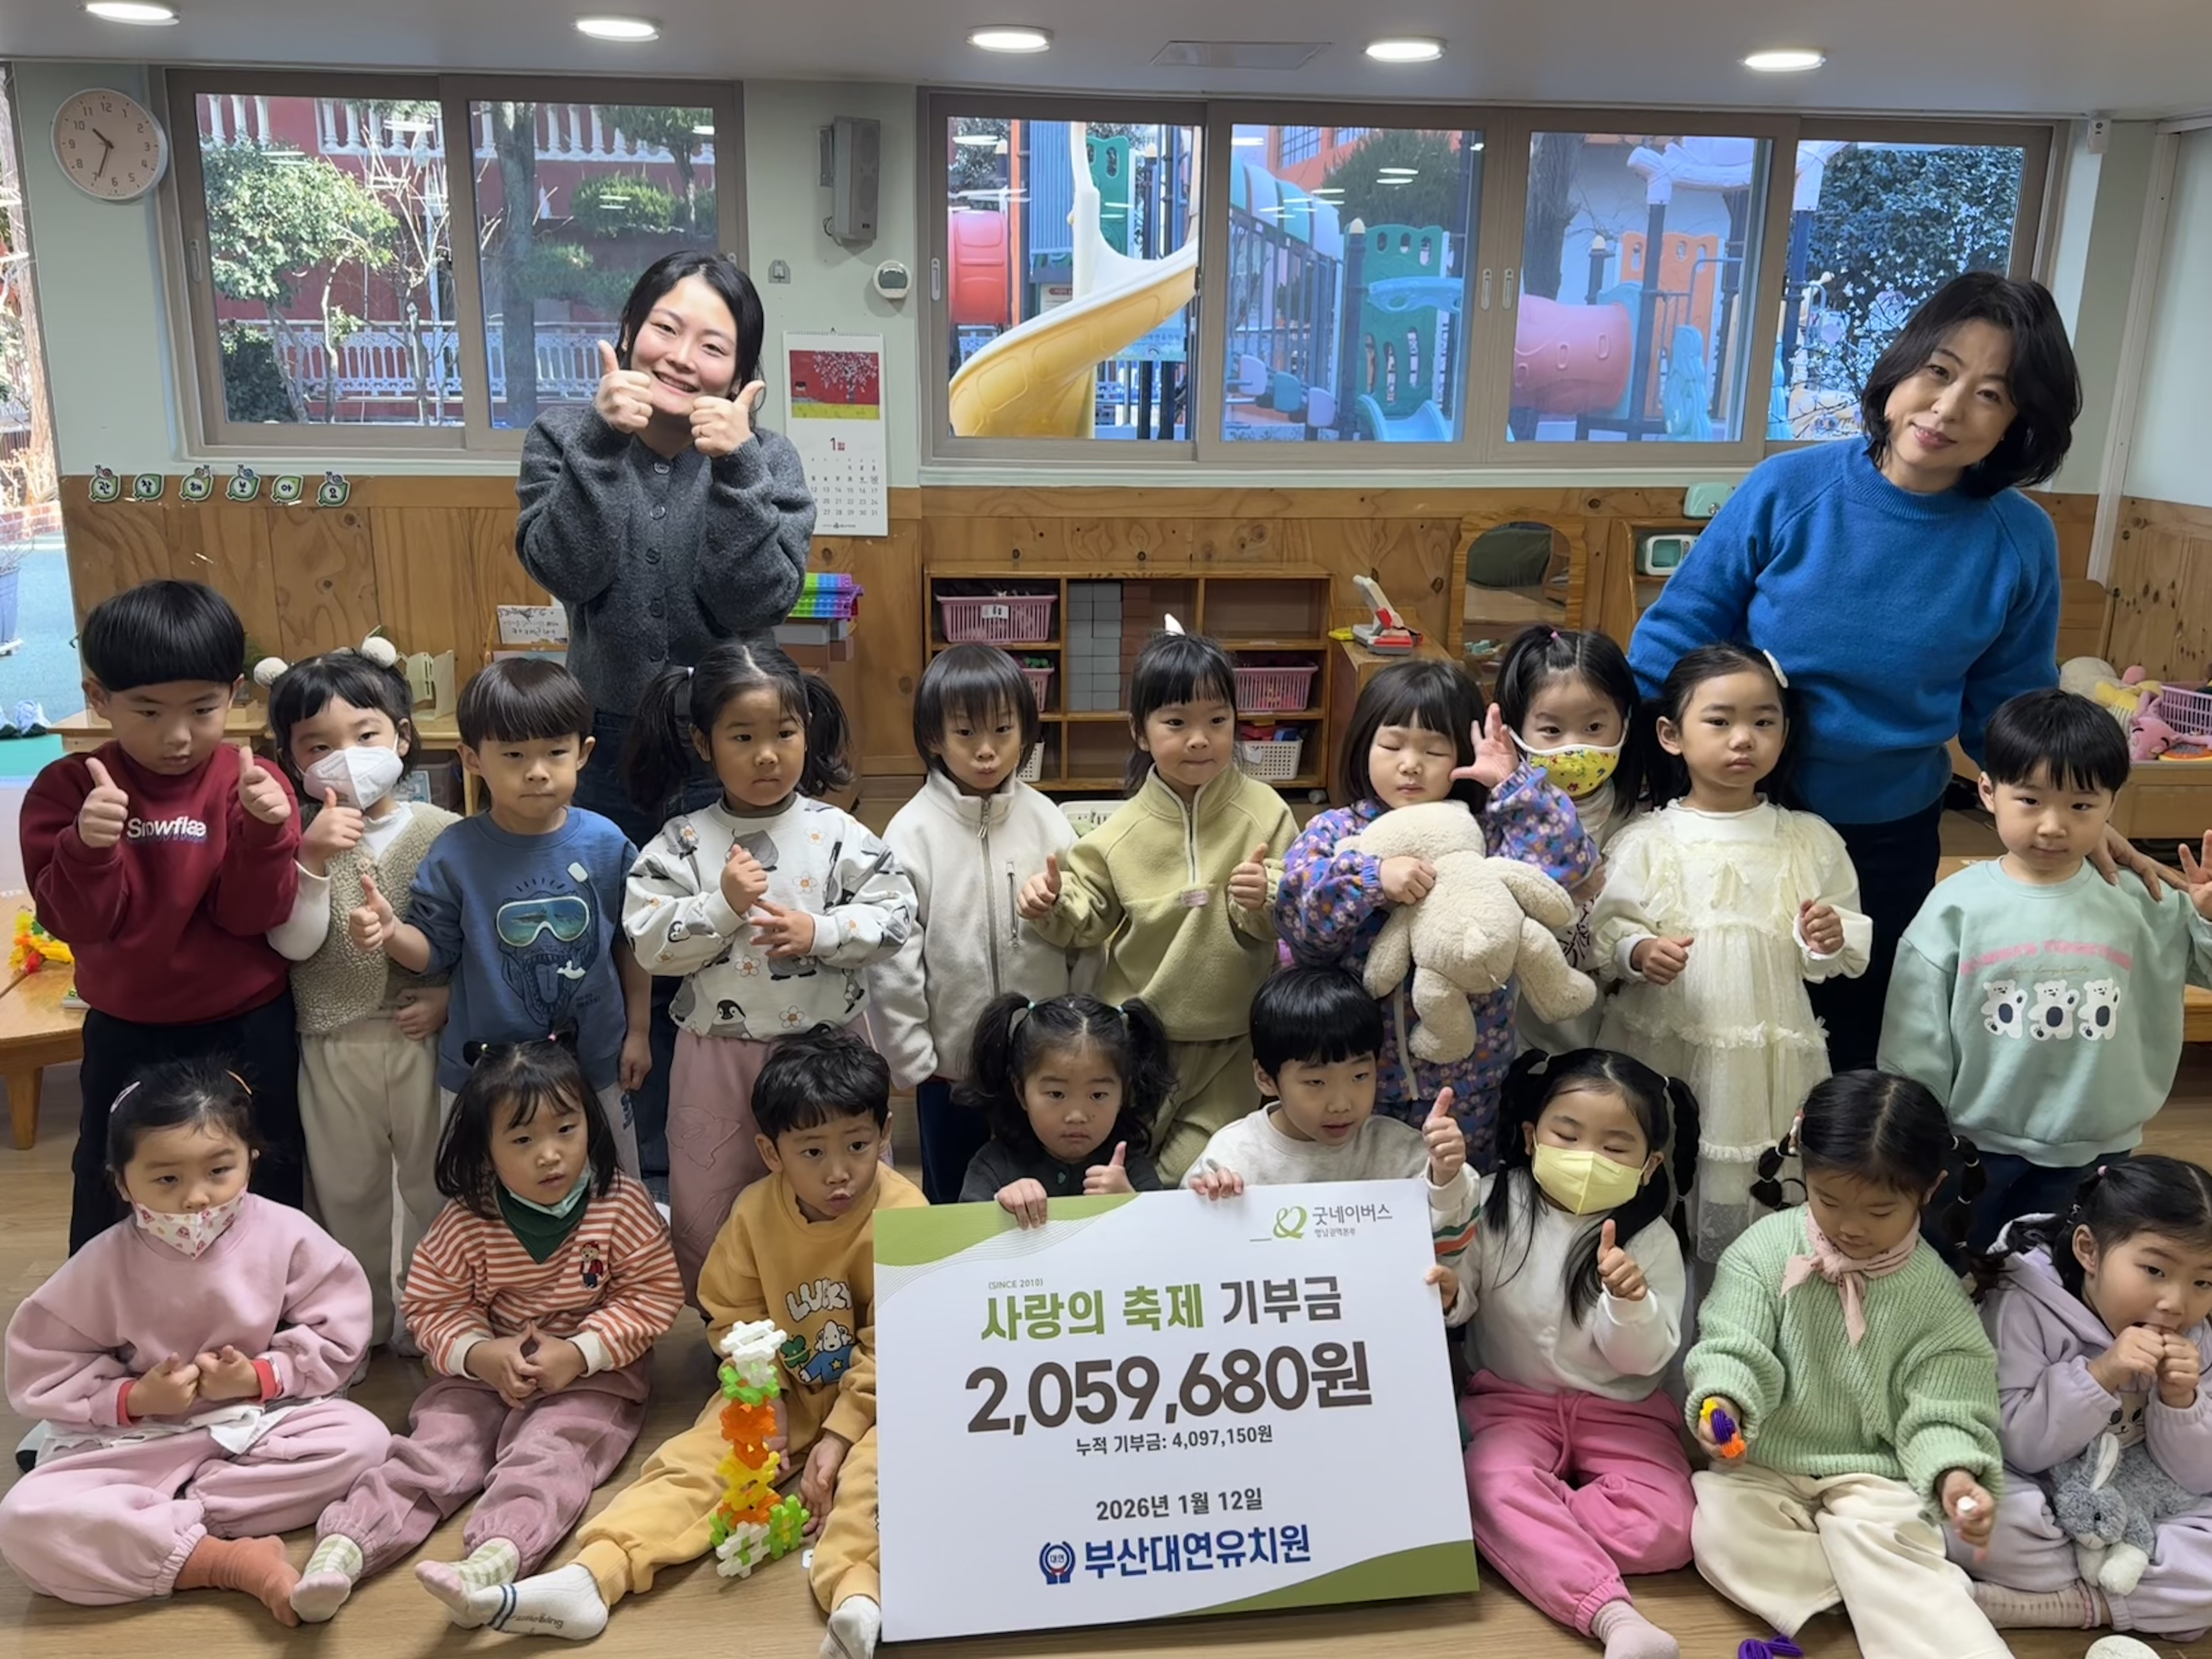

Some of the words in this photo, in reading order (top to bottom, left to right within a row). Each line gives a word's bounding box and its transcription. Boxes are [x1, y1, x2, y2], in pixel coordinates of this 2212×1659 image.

[83, 107, 93, 116] 11
[101, 102, 112, 112] 12
[122, 109, 127, 118] 1
[73, 120, 85, 131] 10
[137, 123, 144, 133] 2
[69, 139, 75, 148] 9
[144, 142, 150, 151] 3
[76, 159, 82, 168] 8
[112, 177, 118, 187] 6
[128, 172, 135, 182] 5
[1313, 1204, 1393, 1226] 굿네이버스
[988, 1279, 1017, 1290] (SINCE
[1020, 1278, 1043, 1288] 2010)
[981, 1290, 1104, 1341] 사랑의
[1123, 1284, 1204, 1331] 축제
[1221, 1276, 1341, 1324] 기부금
[965, 1340, 1372, 1436] 2,059,680원
[1076, 1437, 1107, 1456] 누적
[1114, 1433, 1167, 1453] 기부금:
[1172, 1424, 1273, 1450] 4,097,150원
[1096, 1494, 1170, 1521] 2026년
[1178, 1492, 1209, 1515] 1월
[1218, 1487, 1262, 1511] 12일
[1085, 1524, 1311, 1579] 부산대연유치원
